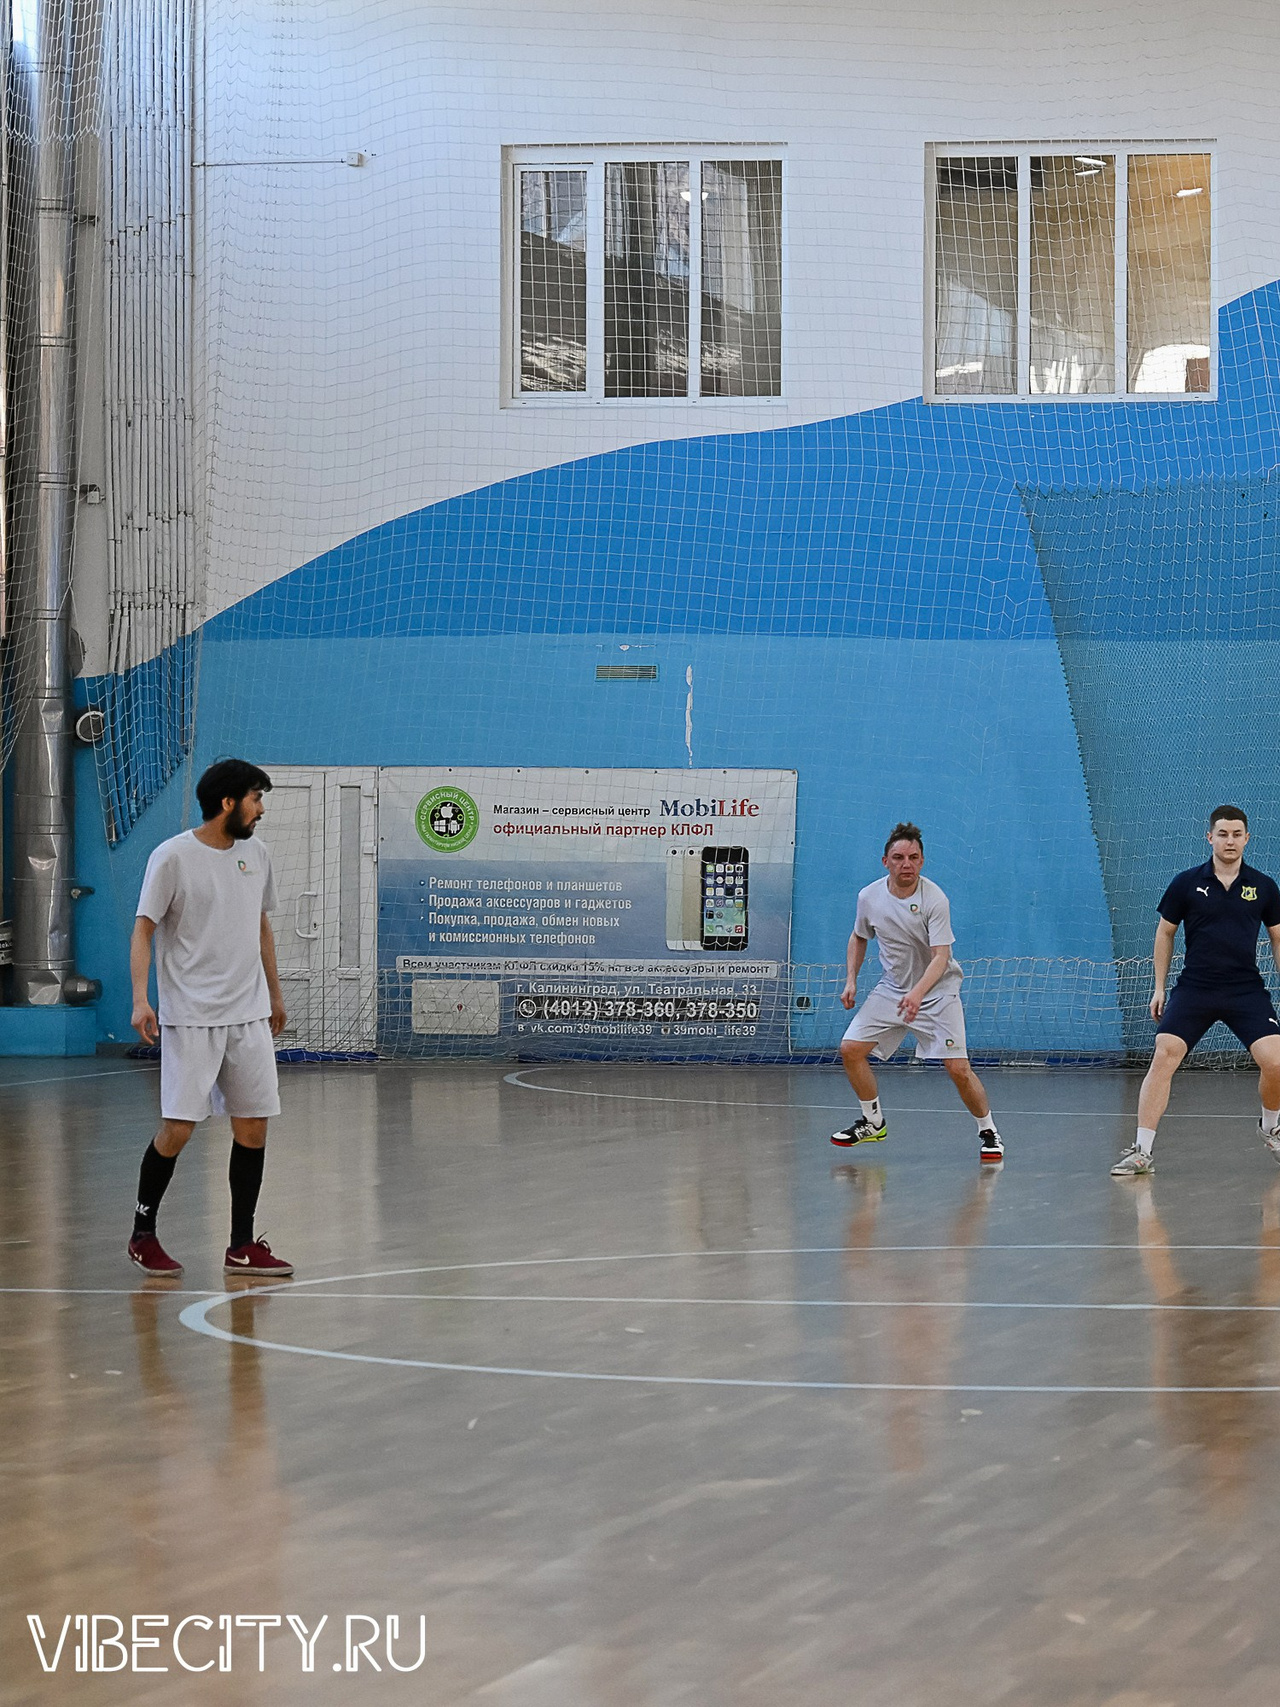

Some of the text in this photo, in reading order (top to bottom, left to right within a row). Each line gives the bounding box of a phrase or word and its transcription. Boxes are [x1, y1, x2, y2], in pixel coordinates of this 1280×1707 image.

[420, 791, 475, 821] СЕРВИСНЫЙ ЦЕНТР
[493, 804, 540, 815] Магазин
[551, 805, 615, 817] сервисный
[618, 807, 651, 818] центр
[659, 797, 760, 817] MobiLife
[493, 821, 714, 839] официальный партнер КЛФЛ
[429, 876, 623, 894] Ремонт телефонов и планшетов
[429, 894, 632, 911] Продажа аксессуаров и гаджетов
[429, 912, 620, 928] Покупка, продажа, обмен новых
[429, 931, 596, 947] и комиссионных телефонов
[403, 959, 432, 969] Всем
[583, 960, 605, 973] 15%
[728, 965, 770, 976] ремонт
[517, 981, 757, 998] г. Калининград, ул. Театральная, 33
[543, 999, 757, 1020] (4012) 378-360, 378-350
[530, 1022, 653, 1035] vk.com/39mobilife39
[673, 1024, 757, 1039] 39mobi_life39
